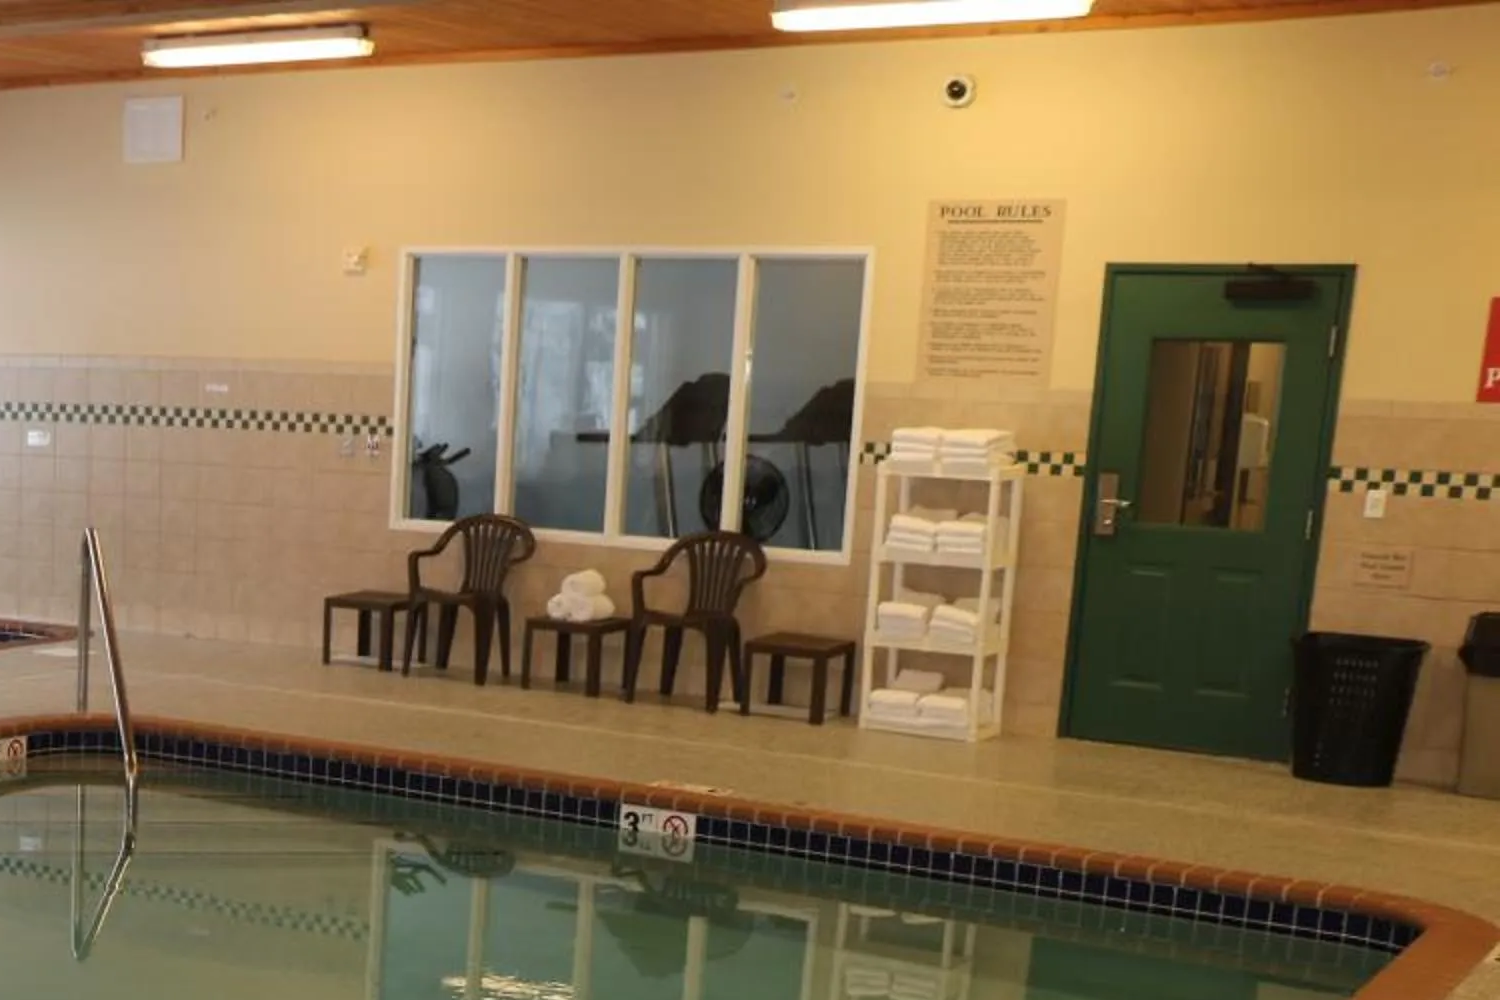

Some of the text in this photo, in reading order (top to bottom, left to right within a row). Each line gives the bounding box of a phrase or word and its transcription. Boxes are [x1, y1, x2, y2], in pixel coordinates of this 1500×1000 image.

[939, 204, 1053, 219] POOL RULES
[623, 811, 640, 833] 3
